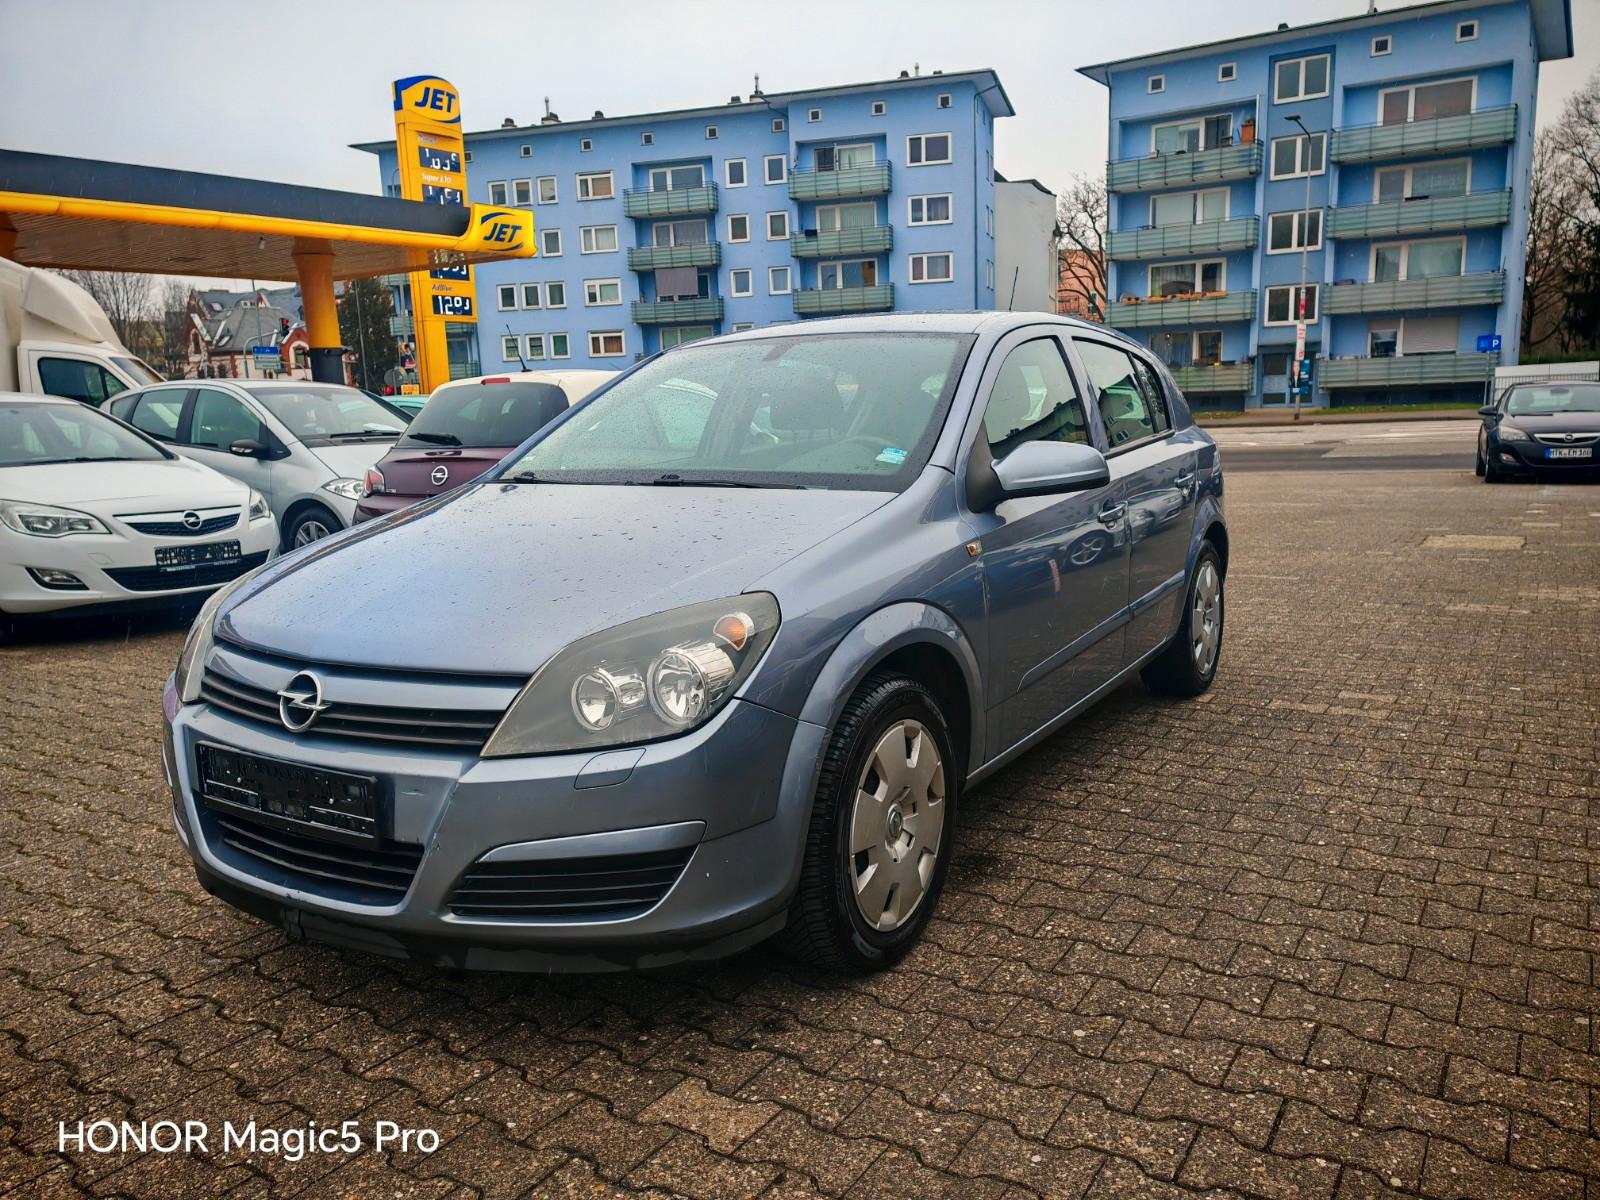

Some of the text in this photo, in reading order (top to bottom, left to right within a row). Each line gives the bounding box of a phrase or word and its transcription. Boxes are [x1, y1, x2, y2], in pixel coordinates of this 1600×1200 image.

[415, 87, 456, 113] JET
[483, 223, 522, 243] JET
[1492, 339, 1499, 348] P
